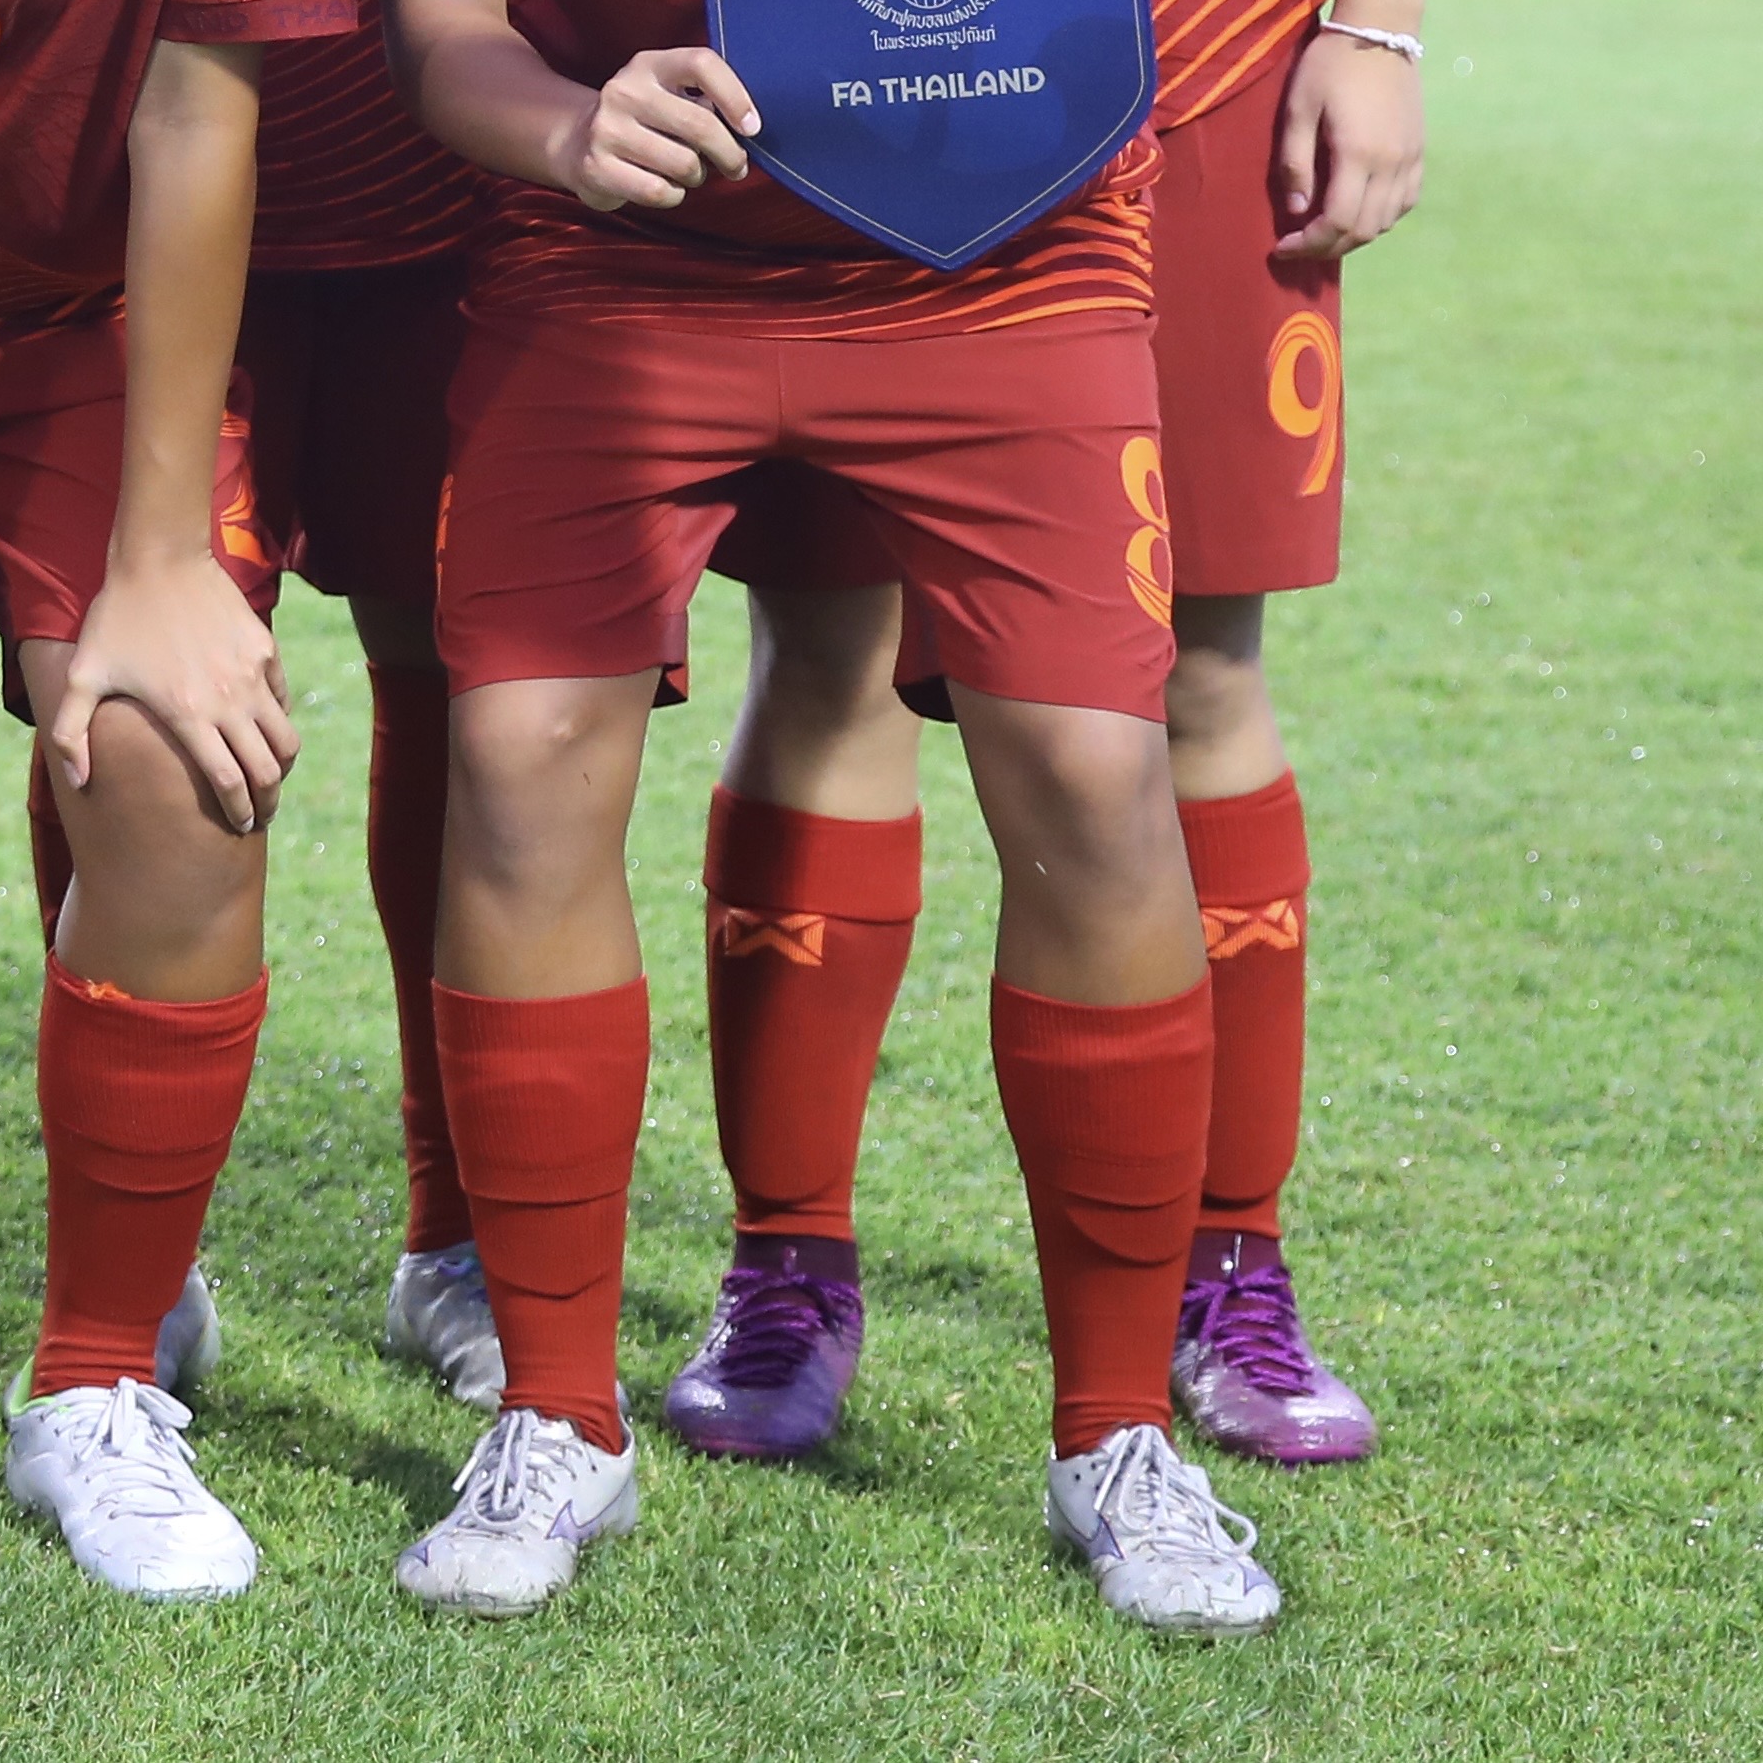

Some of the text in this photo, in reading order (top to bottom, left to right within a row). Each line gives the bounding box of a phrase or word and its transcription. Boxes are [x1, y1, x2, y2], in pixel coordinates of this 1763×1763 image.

[831, 67, 1046, 108] FA THAILAND
[1266, 310, 1341, 498] 9
[1120, 436, 1173, 629] 8
